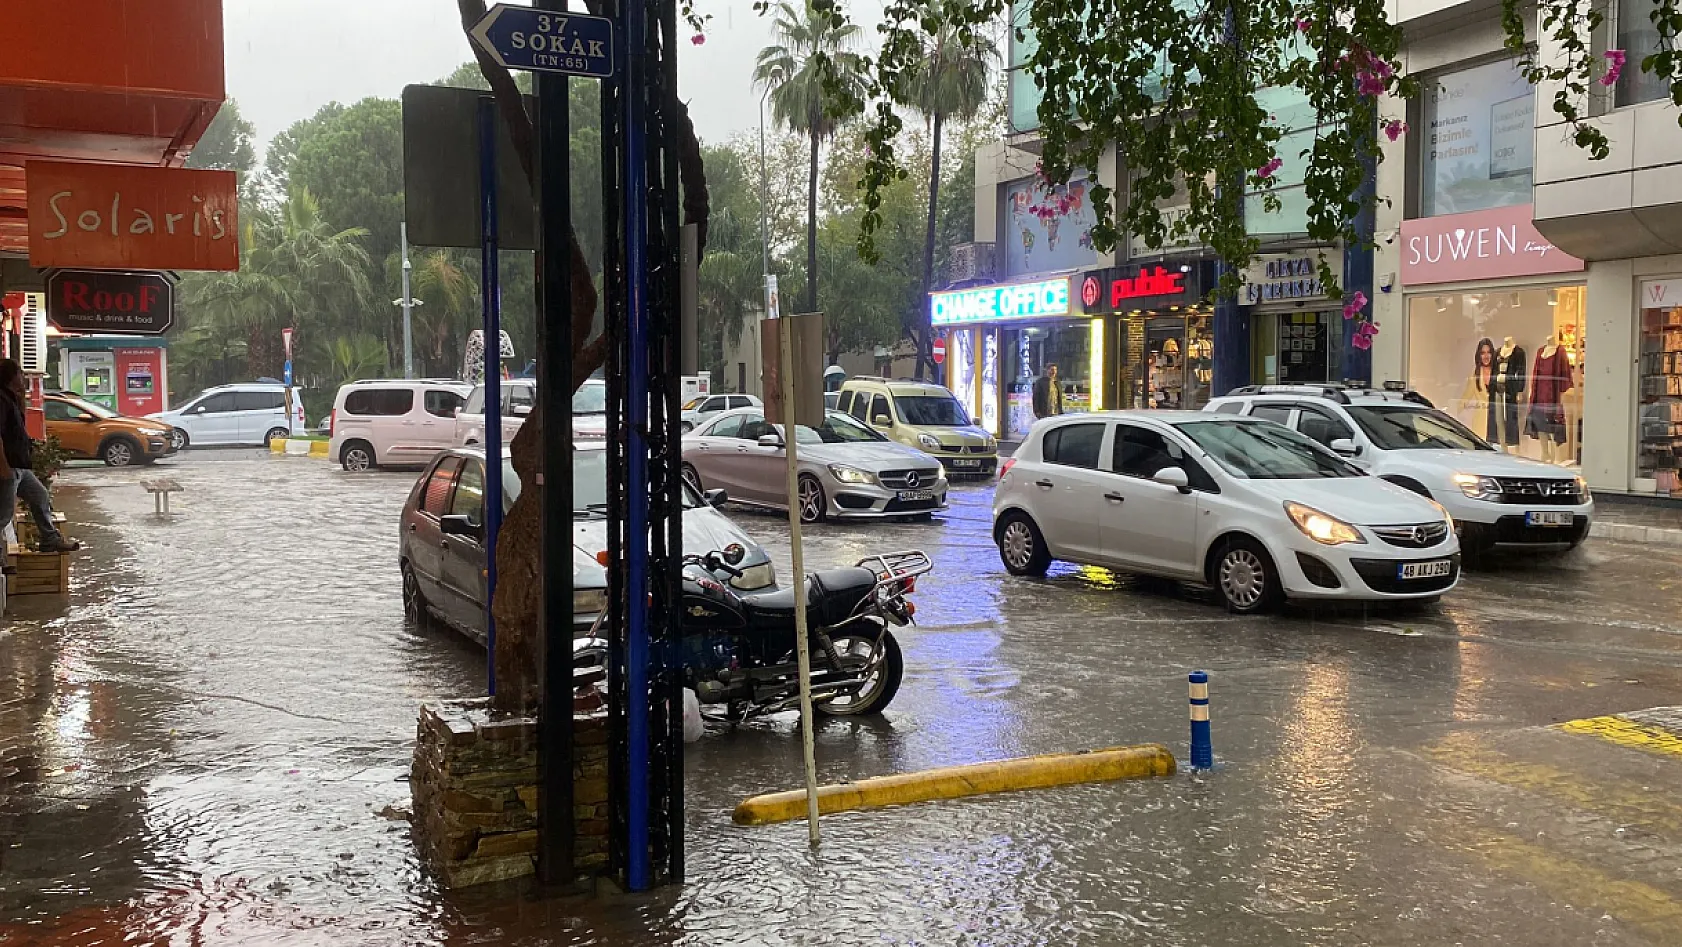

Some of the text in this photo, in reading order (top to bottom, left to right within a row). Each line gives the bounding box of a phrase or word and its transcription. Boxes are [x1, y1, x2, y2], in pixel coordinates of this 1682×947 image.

[511, 31, 605, 58] SOKAK
[532, 53, 589, 71] (TN:65)
[1431, 128, 1472, 145] Bizimle
[43, 191, 225, 240] Solaris
[1409, 225, 1516, 265] SUWEN
[932, 280, 1067, 321] CHANGE OFFICE
[1111, 266, 1185, 308] public
[1262, 278, 1326, 301] MERKEZ
[95, 314, 102, 322] &
[103, 313, 124, 323] drink
[126, 314, 133, 323] &
[135, 315, 153, 324] food
